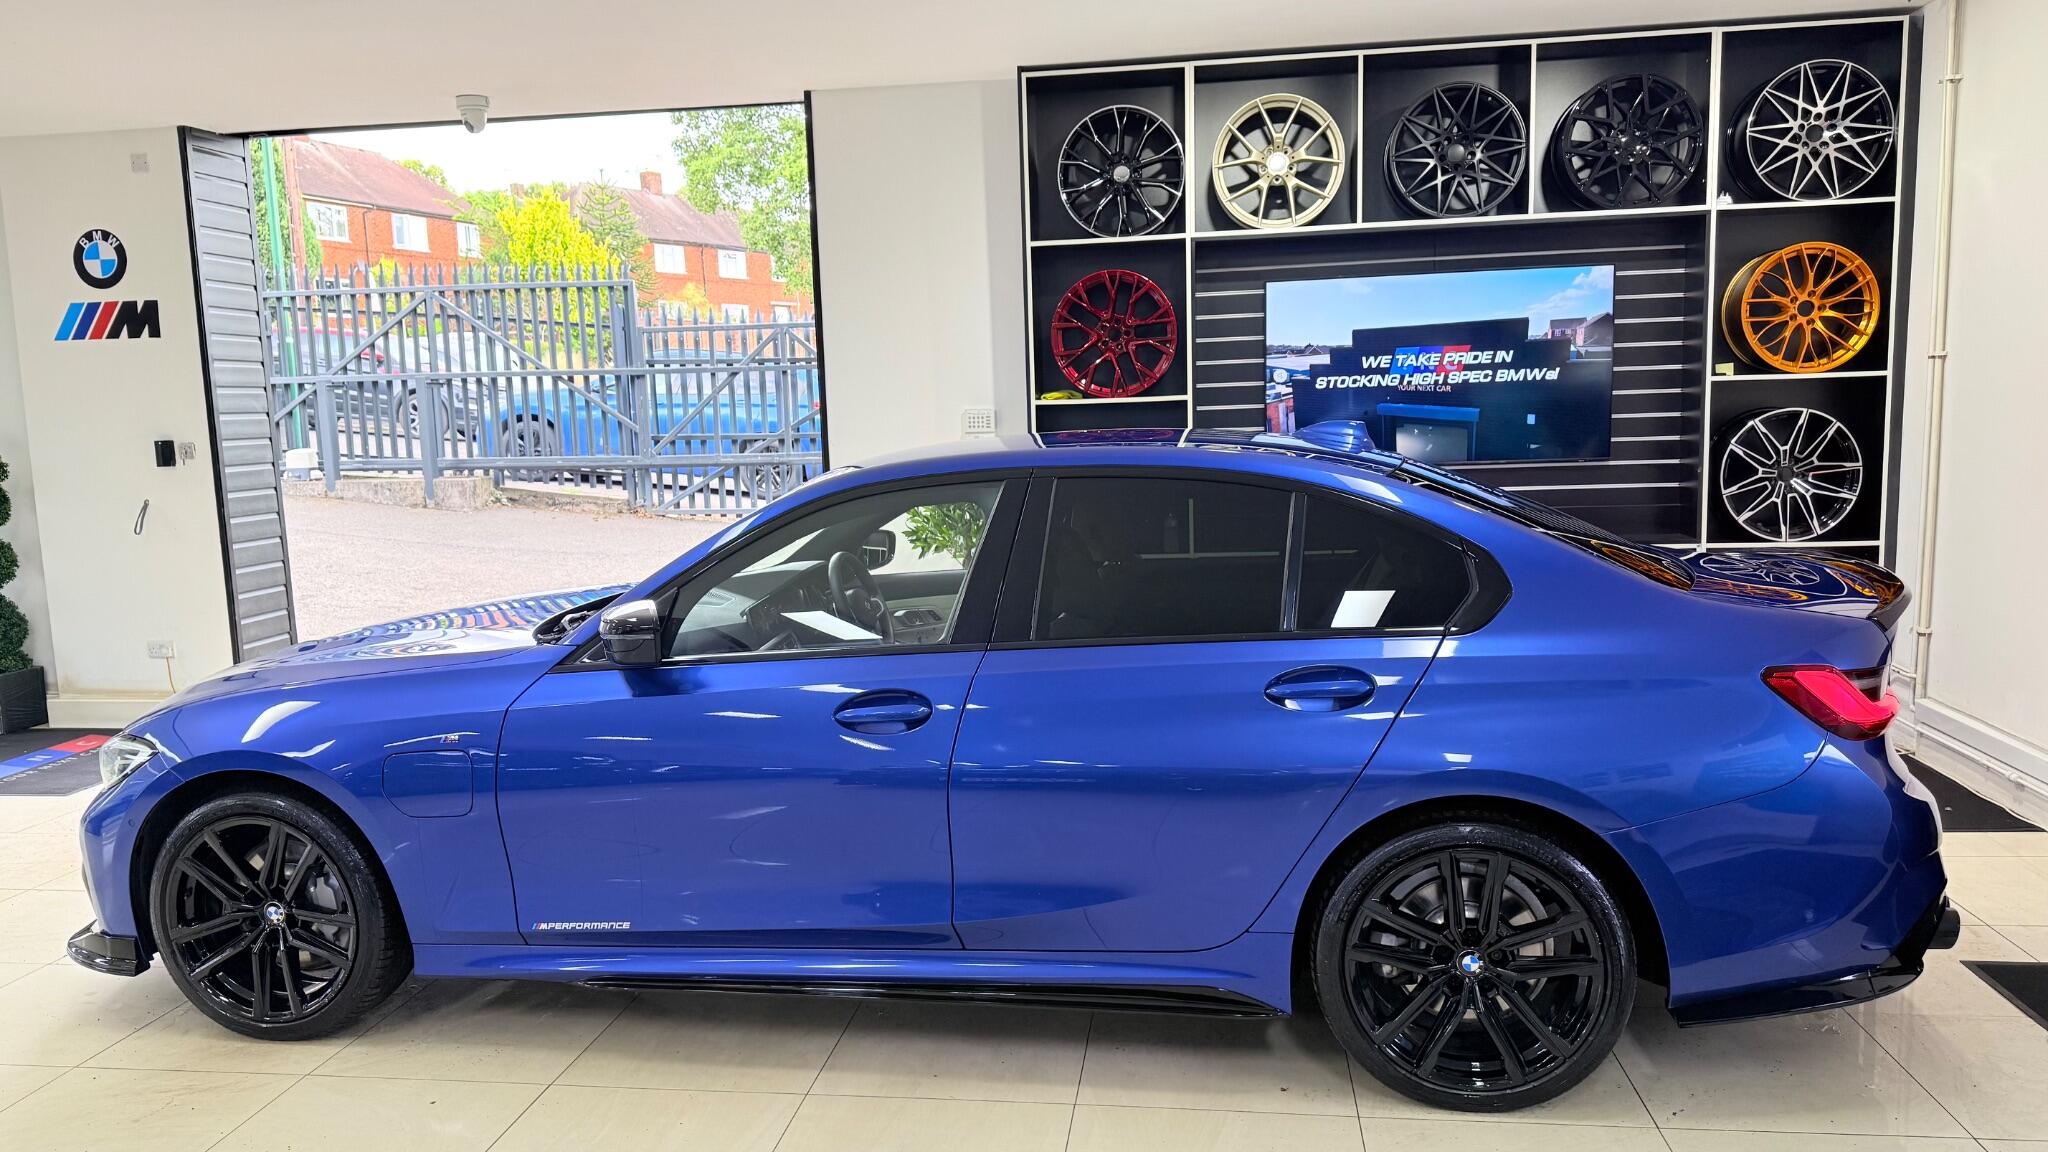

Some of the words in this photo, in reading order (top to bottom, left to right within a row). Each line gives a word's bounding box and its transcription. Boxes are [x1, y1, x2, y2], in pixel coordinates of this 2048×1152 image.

[79, 230, 120, 248] BMW
[1362, 355, 1393, 369] WE
[1396, 353, 1442, 367] TAKE
[1443, 350, 1494, 365] PRIDE
[1495, 350, 1514, 363] IN
[1315, 374, 1400, 389] STOCKING
[1403, 372, 1445, 386] HIGH
[1447, 370, 1493, 384] SPEC
[1397, 384, 1416, 392] YOUR
[1417, 384, 1436, 392] NEXT
[1436, 385, 1452, 393] CAR
